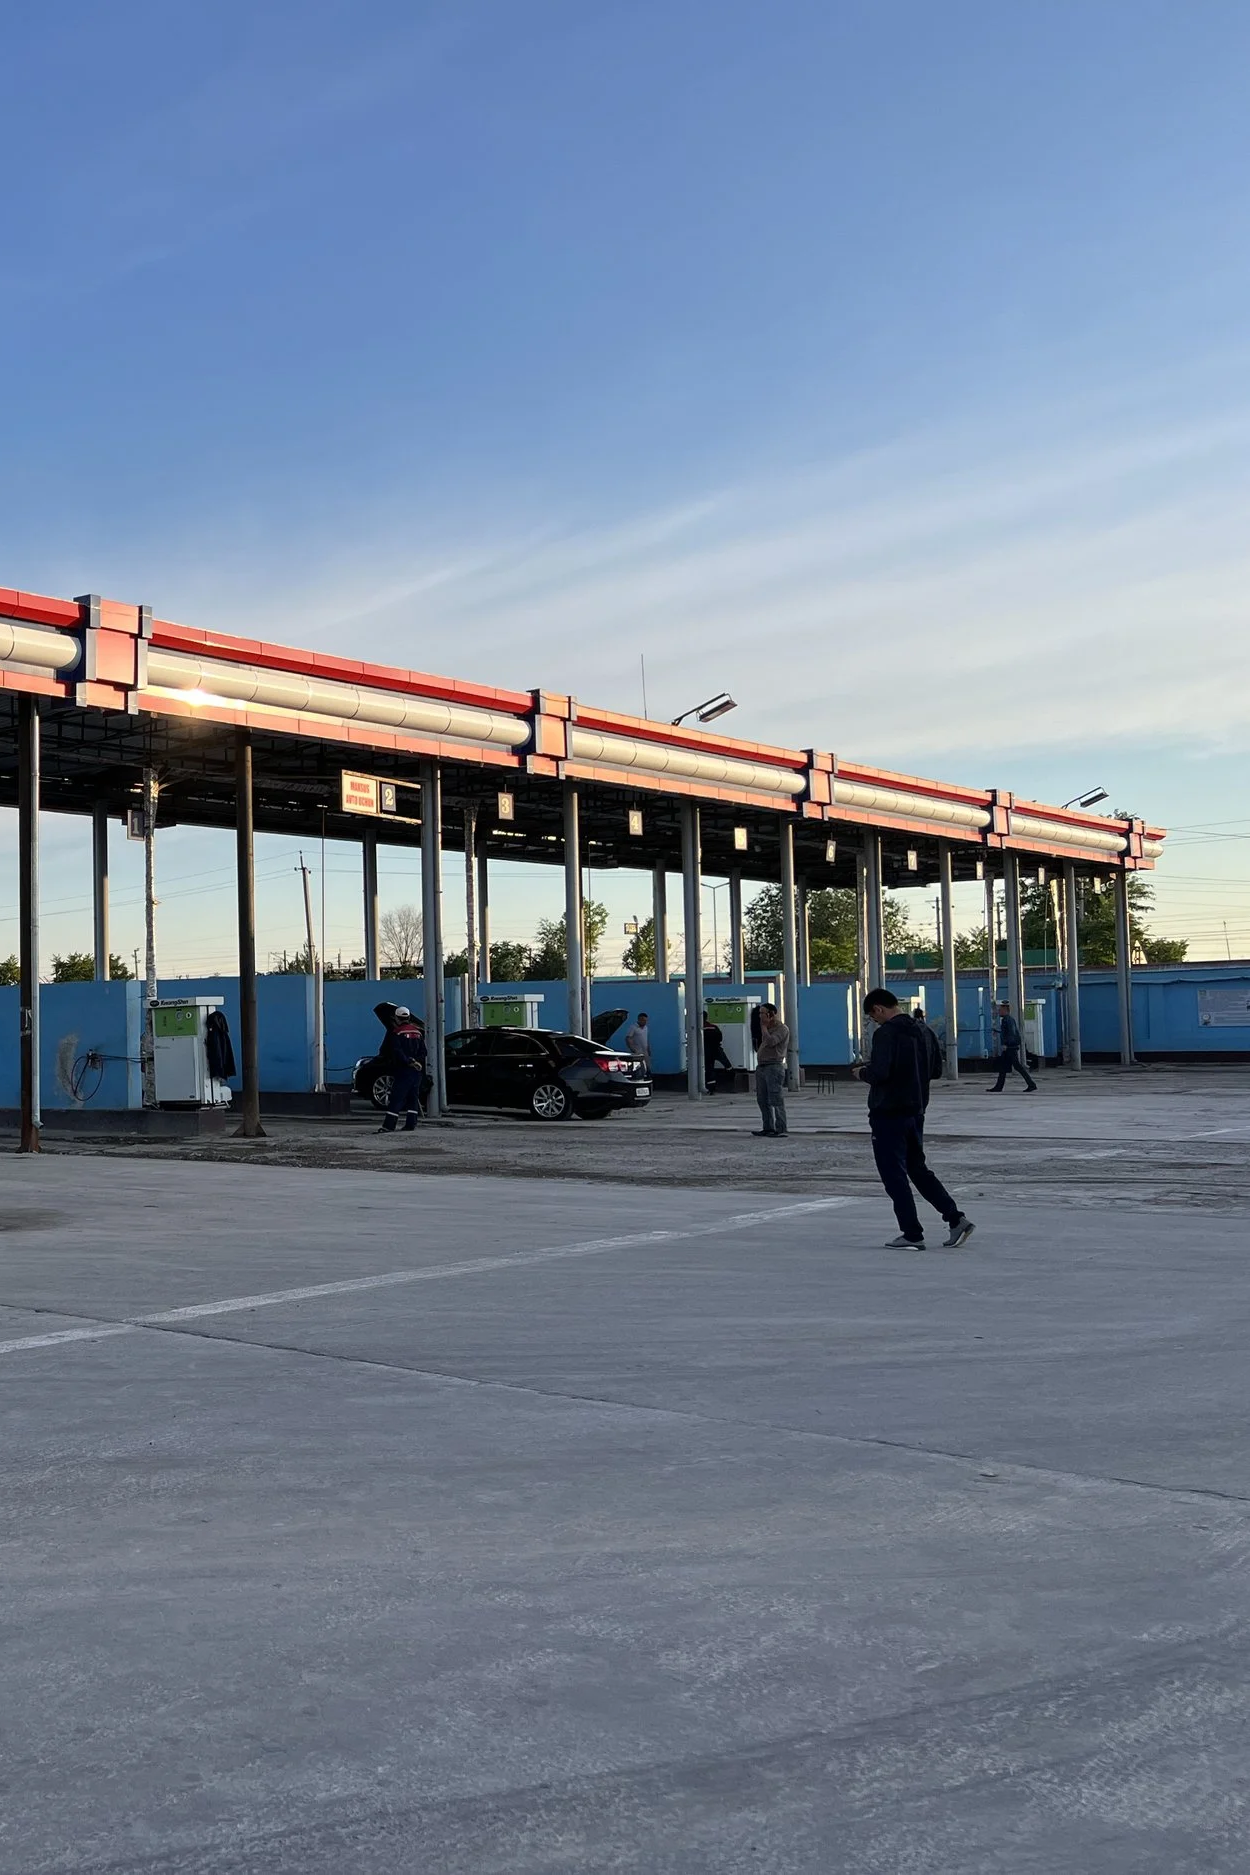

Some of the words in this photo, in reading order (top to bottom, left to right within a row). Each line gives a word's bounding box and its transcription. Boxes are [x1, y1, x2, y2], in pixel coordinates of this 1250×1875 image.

[384, 788, 394, 806] 2
[501, 798, 510, 814] 3
[132, 817, 139, 834] 1
[631, 815, 639, 830] 4
